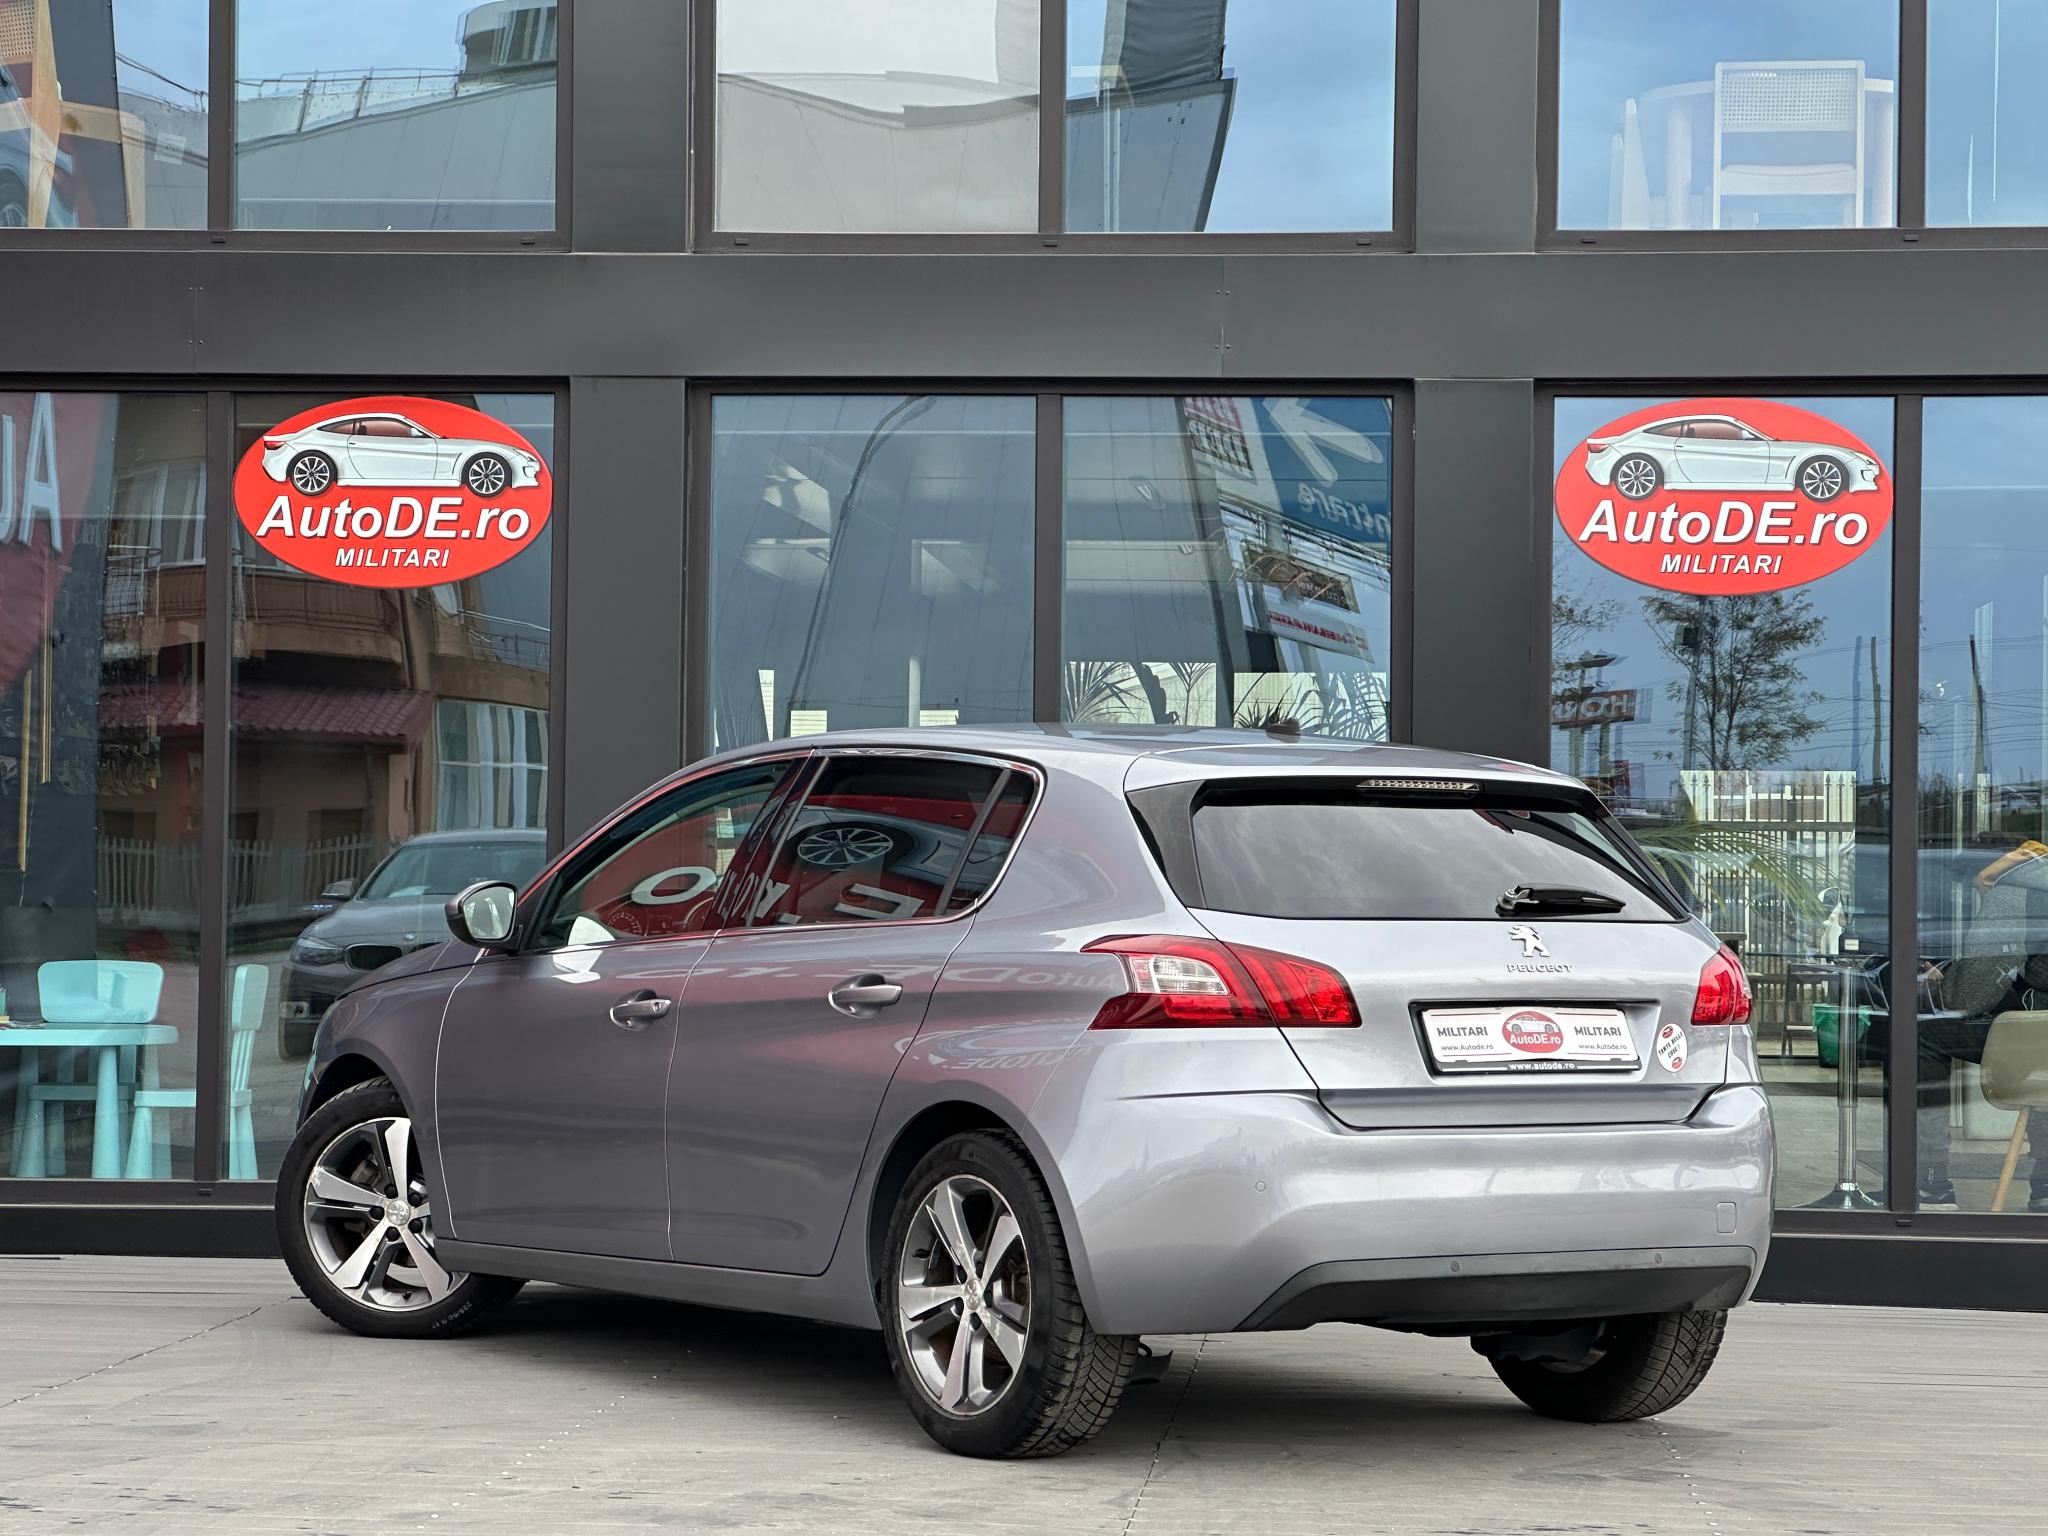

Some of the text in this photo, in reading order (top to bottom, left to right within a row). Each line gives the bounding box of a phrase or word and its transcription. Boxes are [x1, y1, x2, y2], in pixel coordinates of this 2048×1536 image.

[256, 495, 531, 541] AutoDE.ro
[1578, 499, 1869, 546] AutoDE.ro
[334, 548, 450, 568] MILITARI
[1660, 554, 1783, 574] MILITARI
[1506, 963, 1574, 974] PEUGEOT
[1437, 1026, 1488, 1038] MILITARI
[1574, 1025, 1622, 1037] MILITARI
[1509, 1033, 1562, 1046] AutoDE.ro
[1441, 1043, 1494, 1052] www.Autode.ro
[1578, 1042, 1628, 1051] www.Autode.ro
[1508, 1061, 1575, 1071] www.autode.ro
